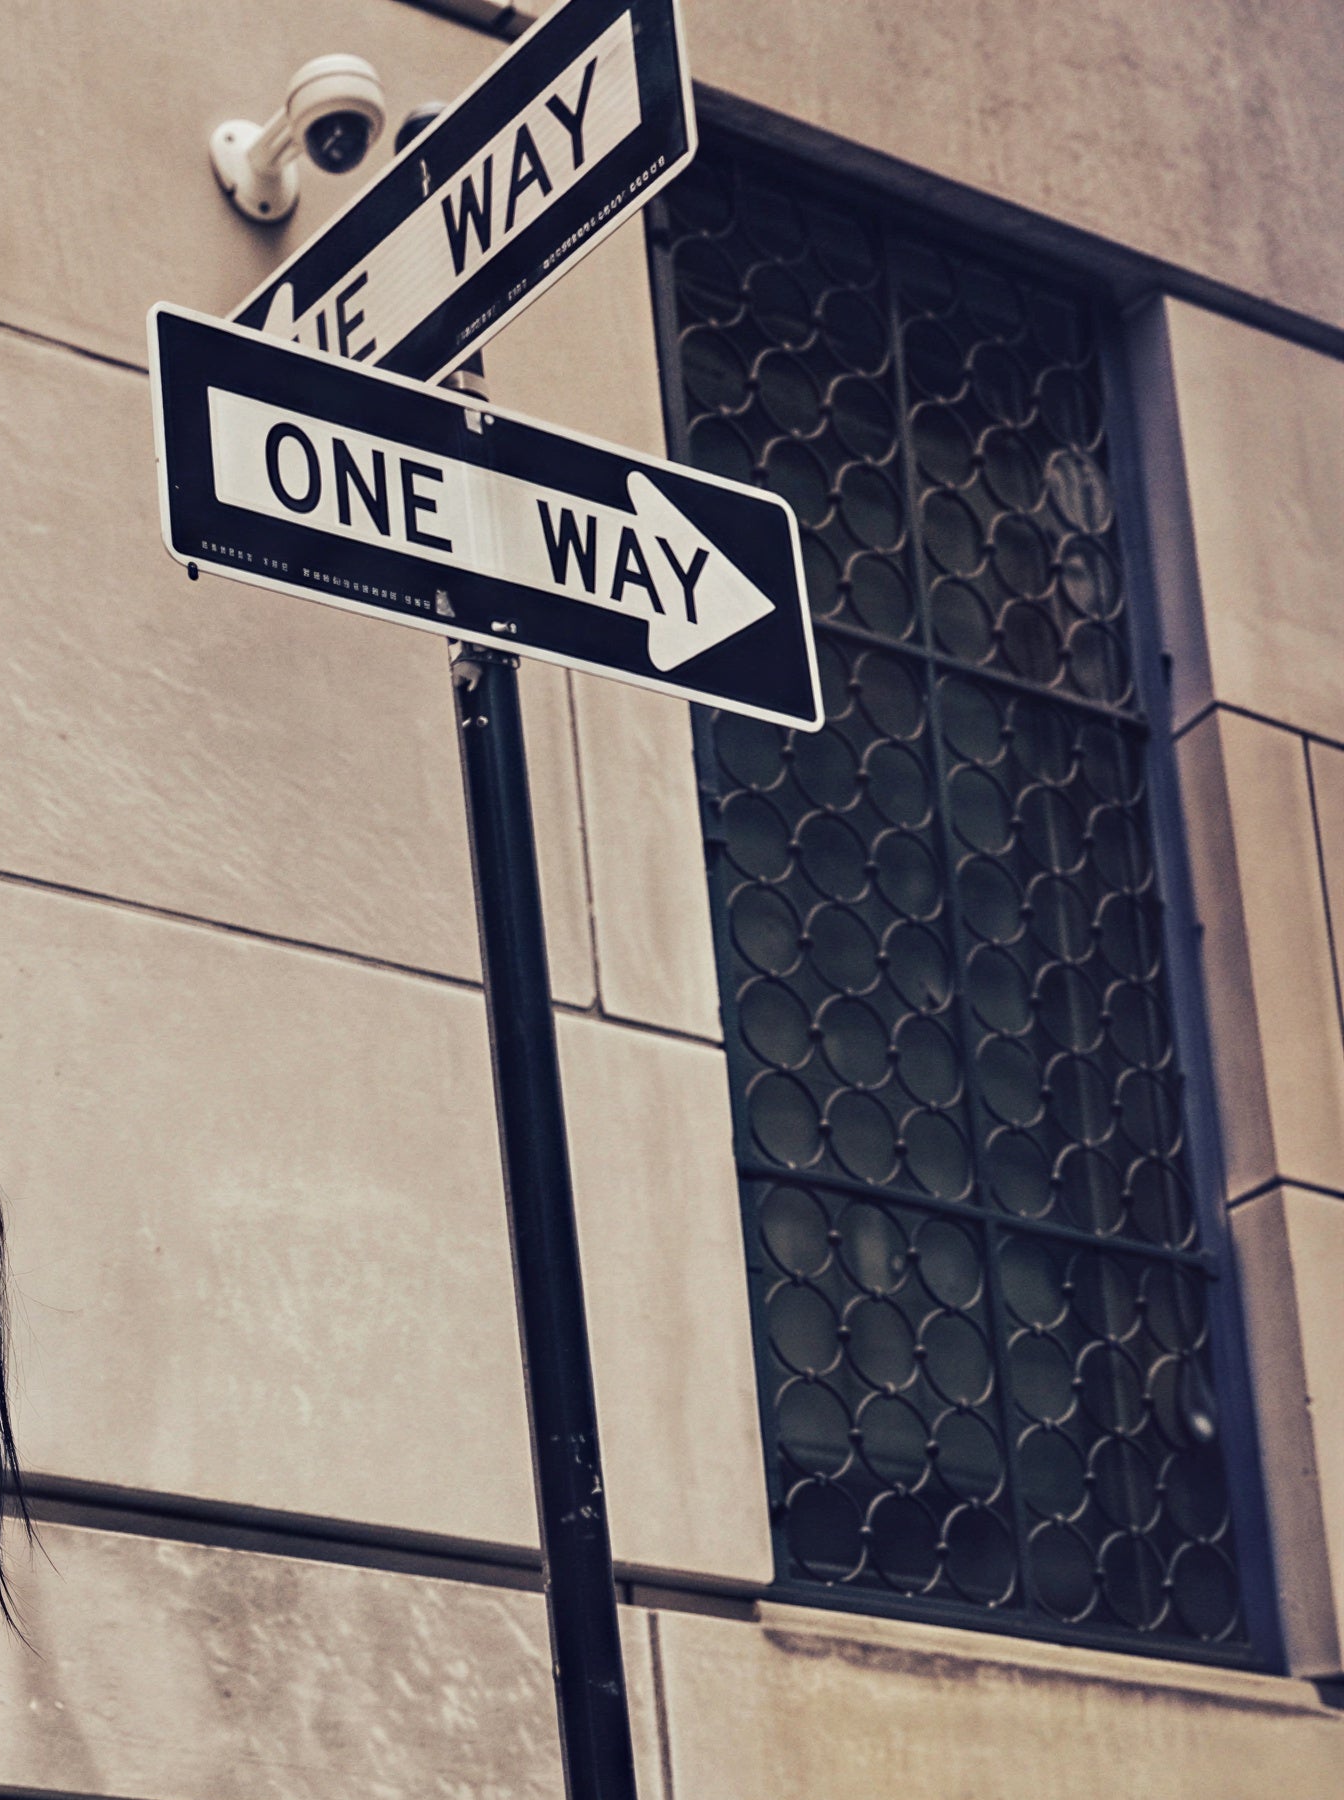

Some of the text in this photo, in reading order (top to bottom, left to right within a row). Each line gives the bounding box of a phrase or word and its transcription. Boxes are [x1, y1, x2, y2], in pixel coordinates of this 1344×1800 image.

[441, 57, 597, 277] WAY
[265, 422, 453, 554] ONE
[536, 499, 710, 625] WAY
